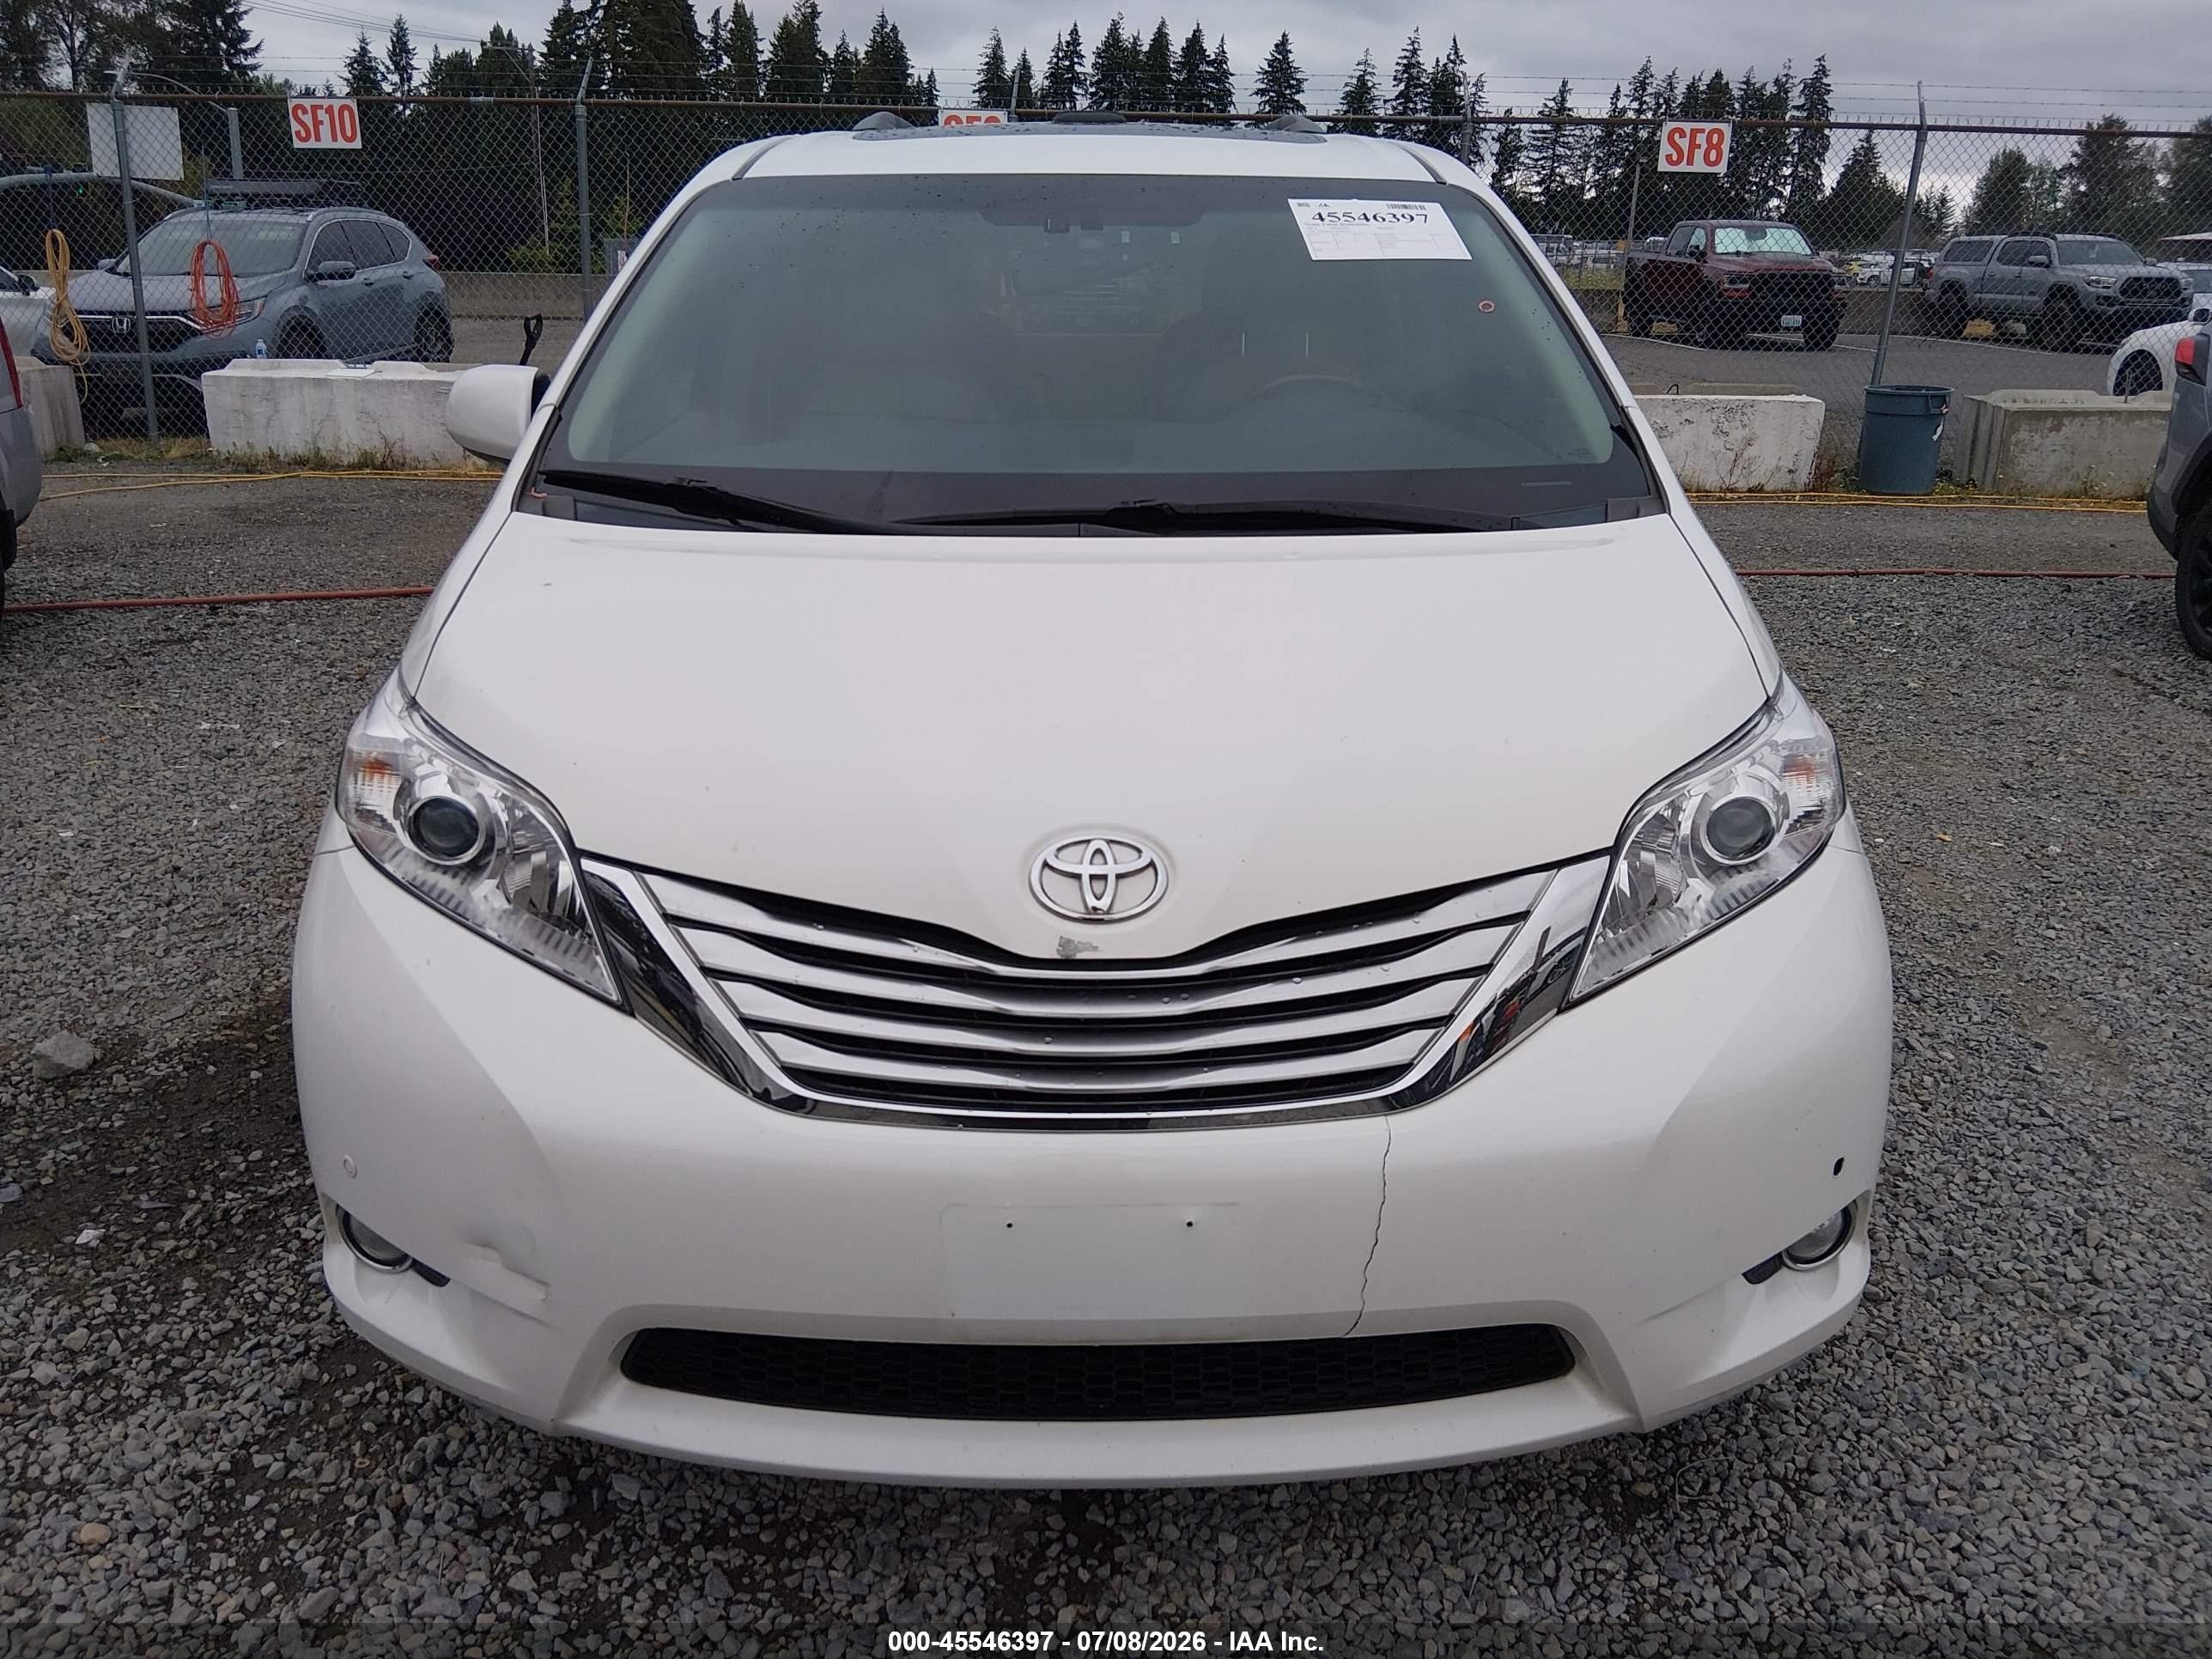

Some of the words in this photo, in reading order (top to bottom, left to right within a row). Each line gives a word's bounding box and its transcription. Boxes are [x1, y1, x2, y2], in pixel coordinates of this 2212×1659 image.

[292, 104, 357, 143] SF10
[1665, 127, 1725, 167] SF8
[1312, 211, 1428, 224] 45546397
